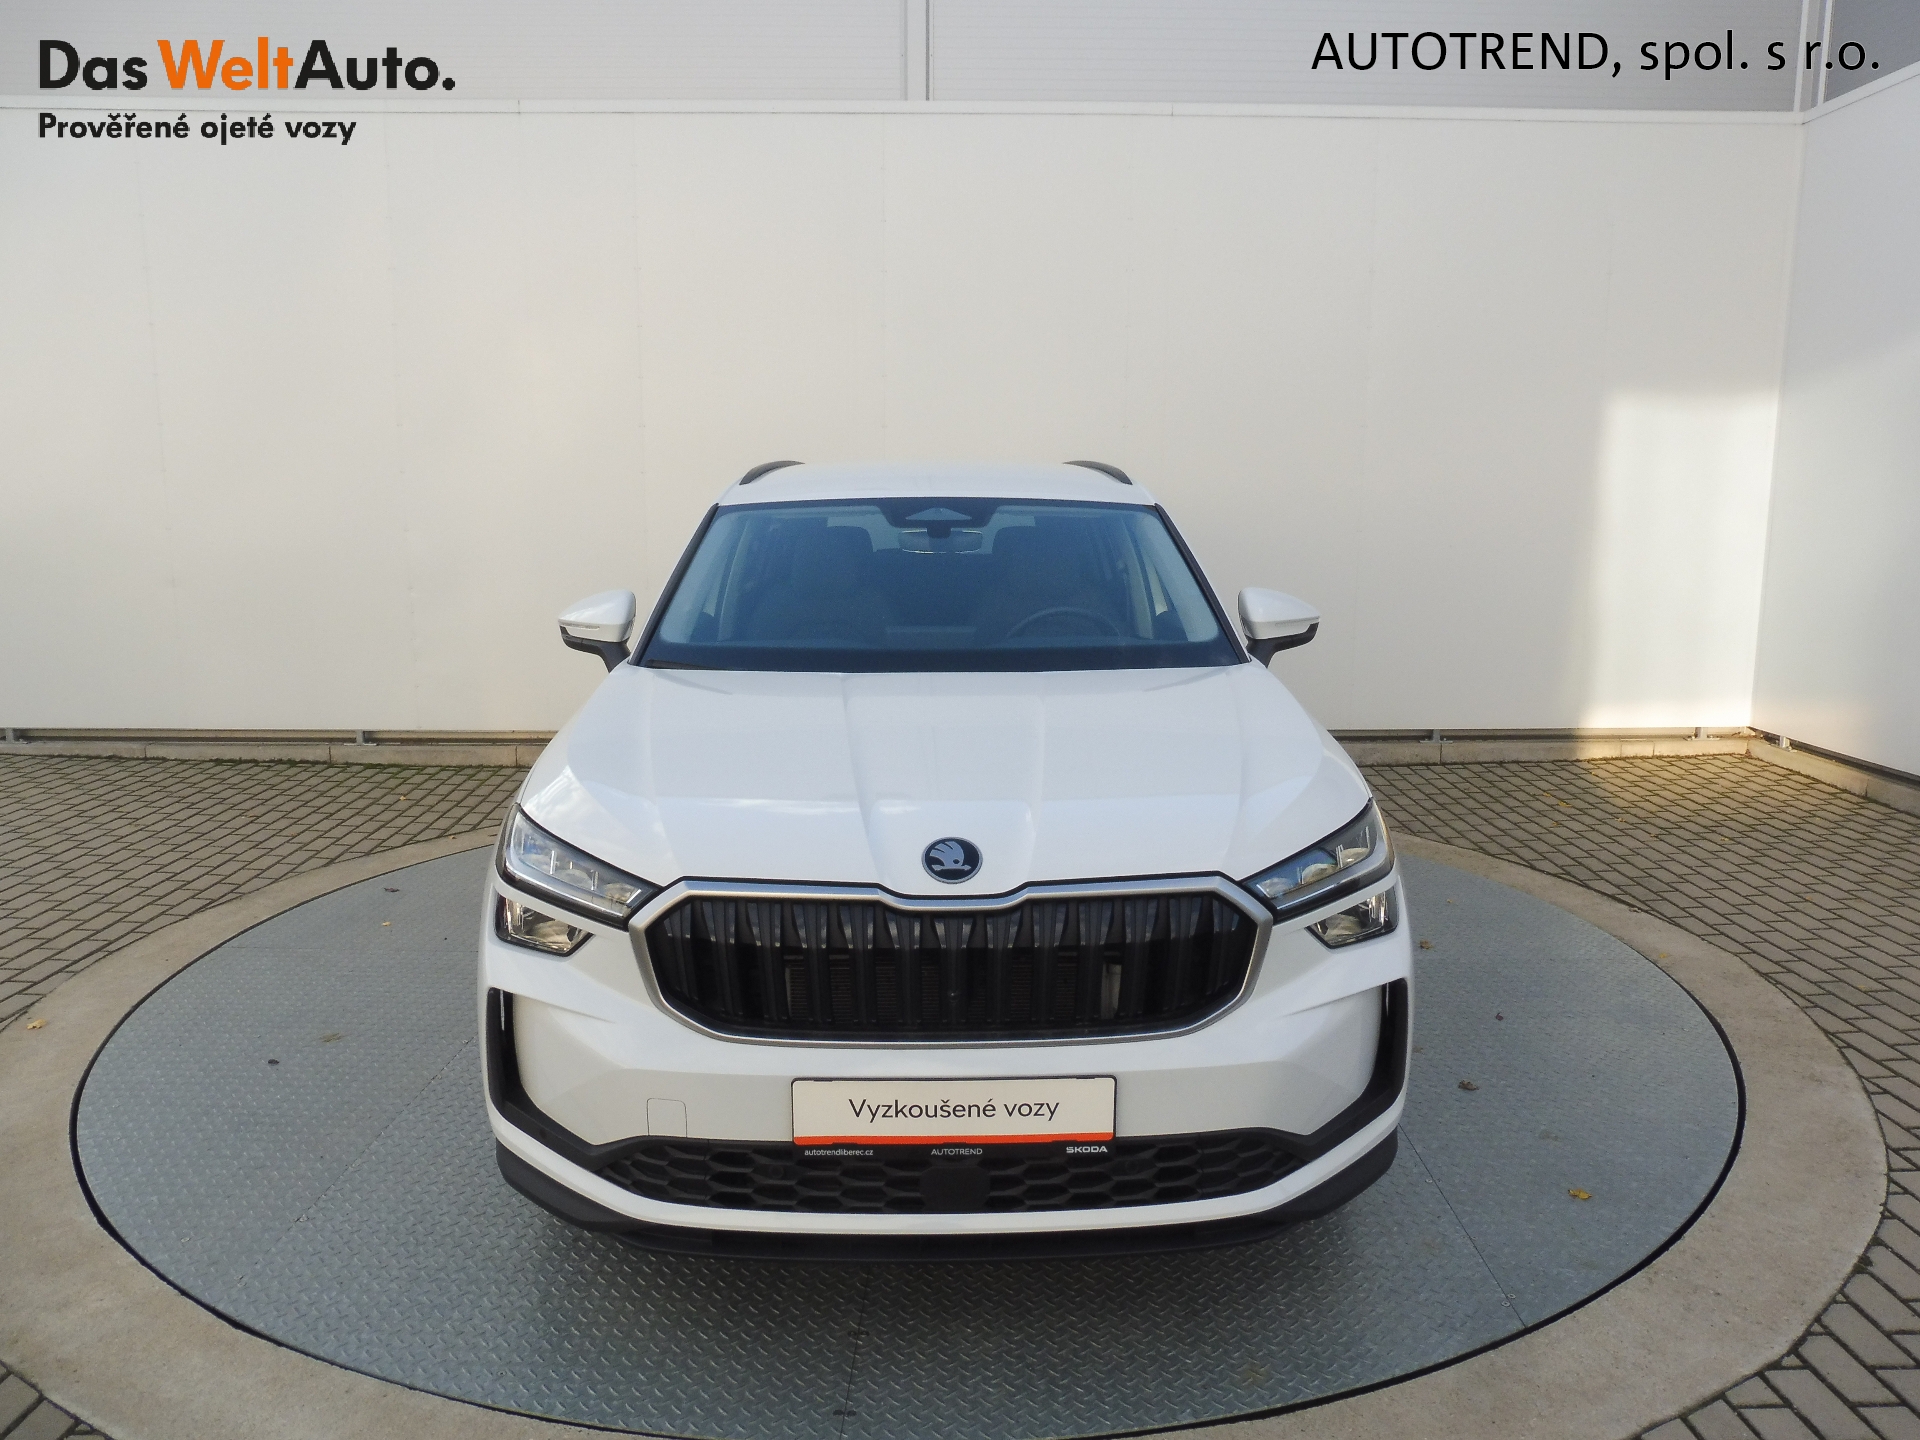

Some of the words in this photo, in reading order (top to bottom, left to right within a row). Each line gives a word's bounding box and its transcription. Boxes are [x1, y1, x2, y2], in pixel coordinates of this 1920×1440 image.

[848, 1098, 997, 1124] Vyzkoušené
[1003, 1101, 1060, 1122] vozy
[804, 1148, 874, 1157] autotrendliberec.cz
[930, 1147, 983, 1156] AUTOTREND
